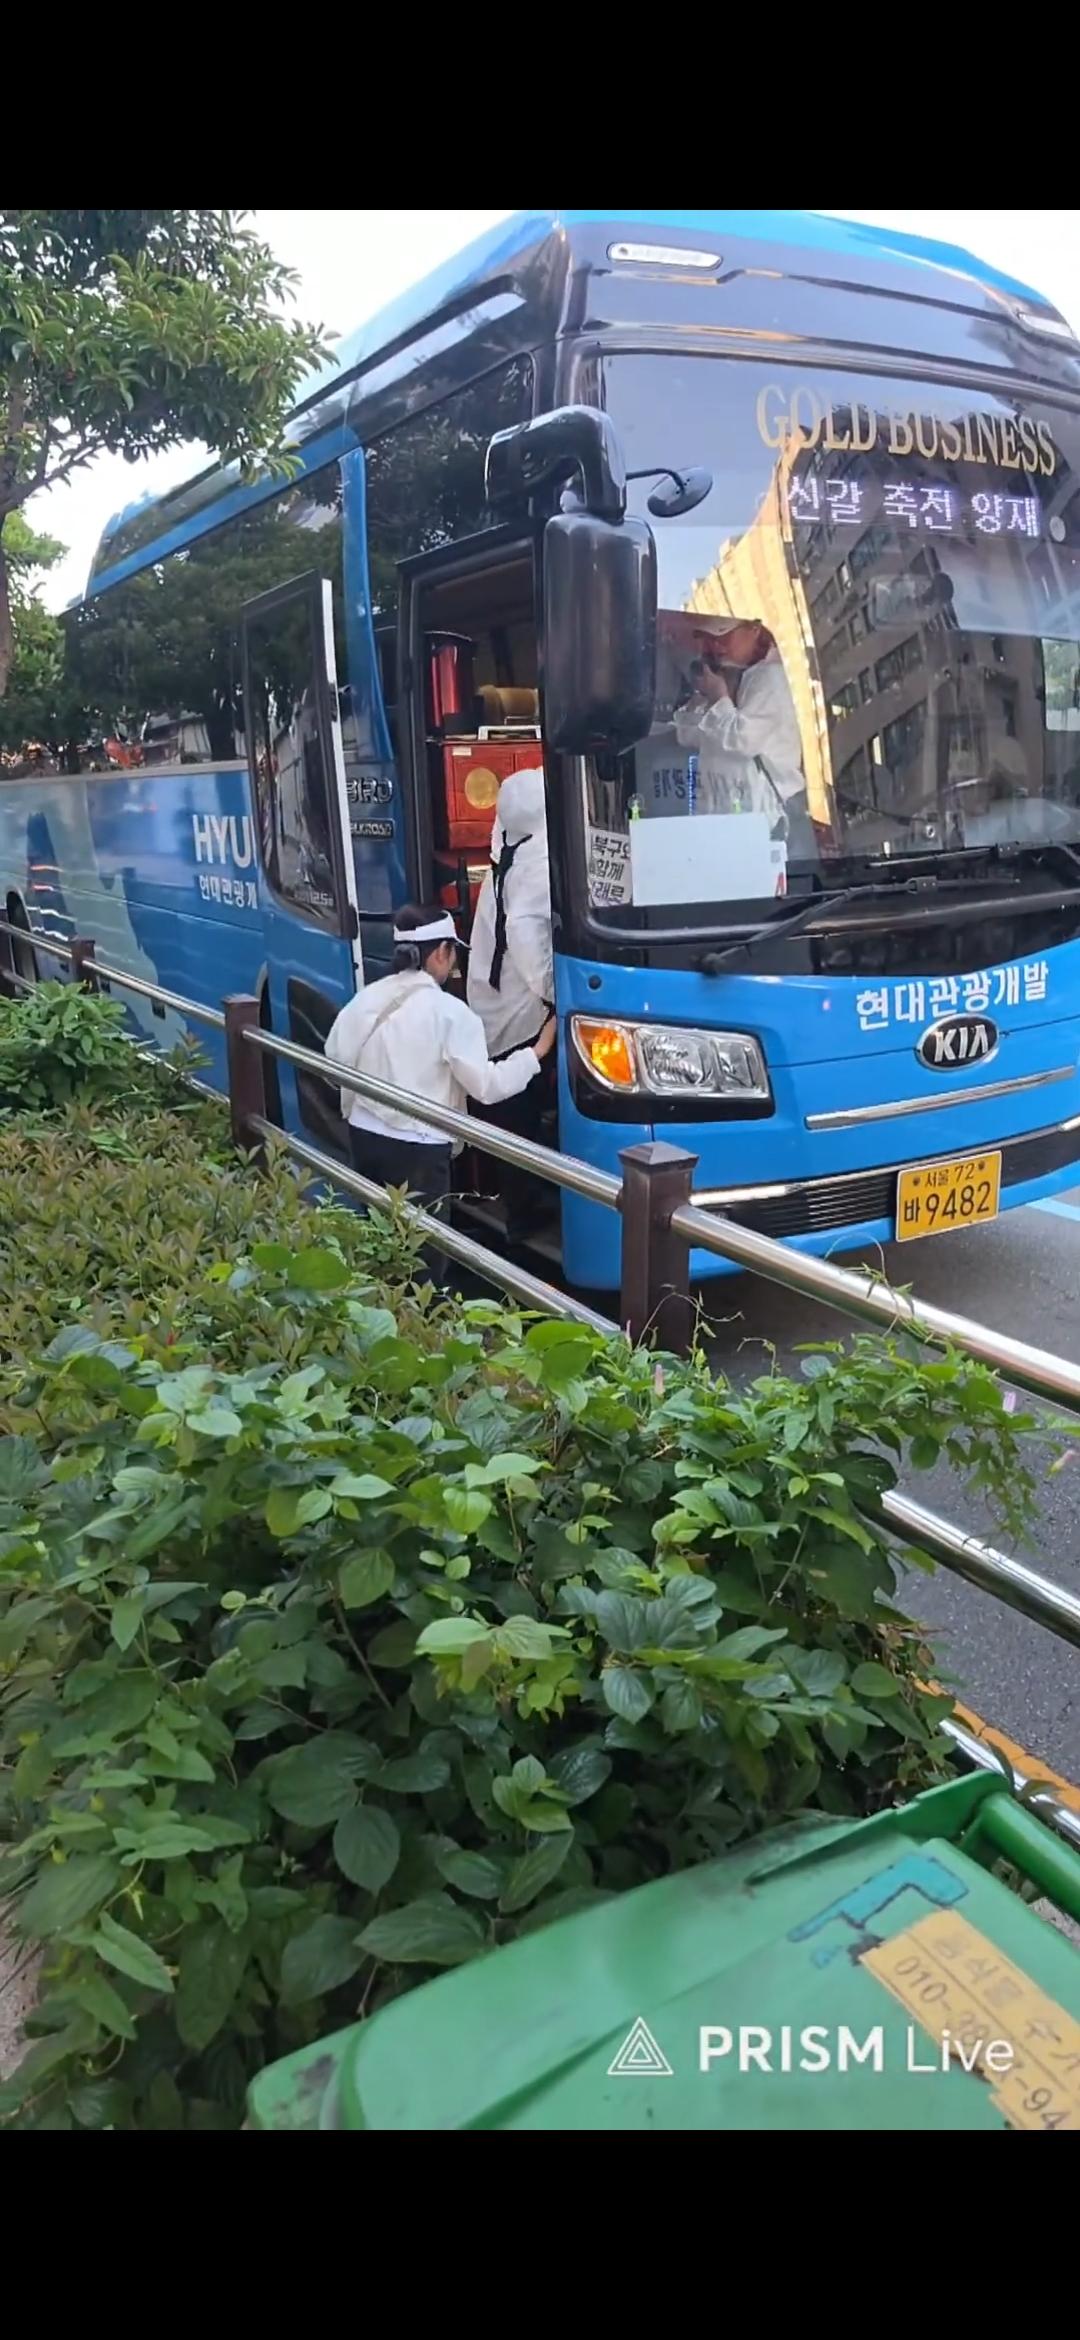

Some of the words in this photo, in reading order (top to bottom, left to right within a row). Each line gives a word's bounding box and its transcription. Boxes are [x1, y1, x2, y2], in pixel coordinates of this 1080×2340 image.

[756, 384, 877, 451] GOLD
[888, 410, 1056, 476] BUSINESS
[788, 476, 864, 525] 신갈
[971, 494, 1040, 537] 양재
[192, 814, 258, 869] HYU
[856, 960, 1049, 1031] 현대관광개발
[933, 1023, 989, 1063] KIA
[925, 1169, 950, 1188] 서울
[954, 1162, 975, 1184] 72
